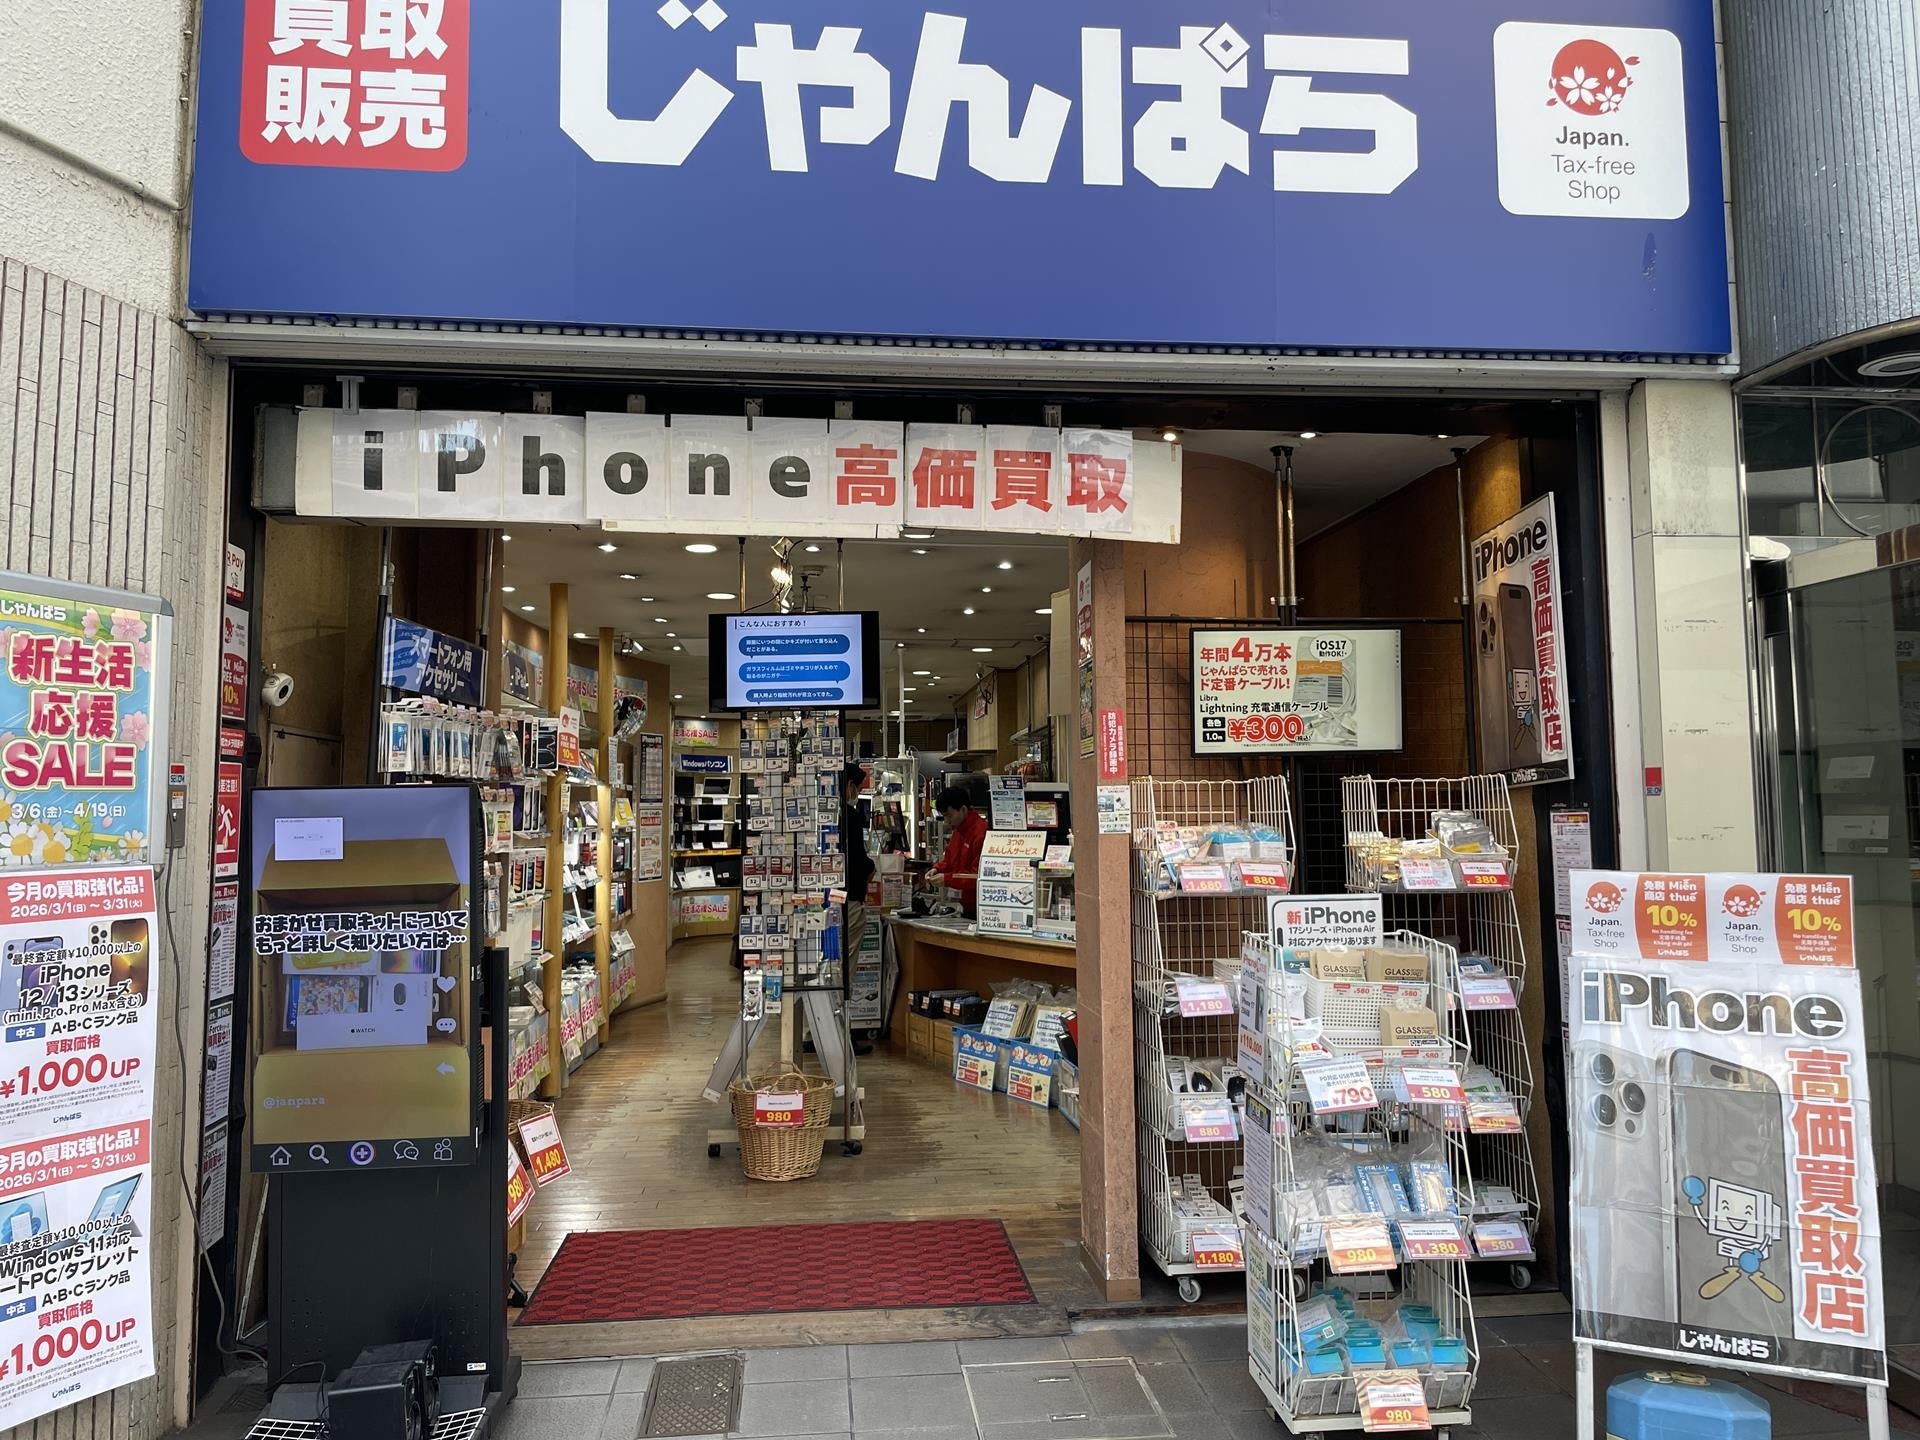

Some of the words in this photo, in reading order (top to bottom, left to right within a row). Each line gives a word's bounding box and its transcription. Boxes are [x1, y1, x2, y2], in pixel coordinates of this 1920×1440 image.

[269, 0, 448, 59] 買取
[560, 0, 1419, 194] じゃんぱら
[261, 65, 448, 149] 販売
[1556, 127, 1630, 150] Japan.
[1551, 154, 1635, 175] Tax-free
[1568, 180, 1620, 204] Shop
[1475, 519, 1548, 583] iPhone
[1, 601, 67, 621] じゃんぱら
[739, 620, 806, 628] こんな人におすすめ！
[1316, 640, 1347, 650] iOS17
[11, 634, 134, 689] 新生活
[409, 634, 472, 673] スマートフォン用
[1531, 557, 1564, 753] 高価買取店
[416, 662, 465, 693] アクセサリー
[1200, 665, 1288, 677] じゃんぱらで売れる
[1200, 677, 1290, 691] ド定番ケーブル!
[224, 685, 239, 705] 10%
[31, 692, 116, 739] 応援
[1200, 704, 1248, 715] Lightning
[1251, 702, 1328, 713] 充電通信ケーブル
[1228, 715, 1304, 742] ¥300
[5, 742, 136, 787] SALE
[682, 759, 726, 768] Windowsパソコン
[988, 847, 1038, 855] あんしんサービス
[1253, 876, 1276, 886] 880
[1475, 875, 1498, 885] 380
[1644, 880, 1664, 890] 免税
[1669, 878, 1697, 890] Miễn
[1785, 883, 1807, 894] 免税
[1811, 881, 1841, 894] Miễn
[8, 876, 144, 902] 今月の買取強化品!
[1669, 891, 1698, 902] thuế
[1811, 894, 1842, 906] thuế
[255, 911, 468, 934] おまかせ買取キットについて
[1286, 911, 1301, 925] 新
[1304, 906, 1377, 925] iPhone
[1588, 917, 1622, 929] Japan.
[1647, 904, 1697, 927] 10%
[1787, 908, 1842, 932] 10%
[1587, 929, 1624, 938] Tax-free
[1725, 921, 1761, 932] Japan.
[255, 933, 467, 955] もっと詳しく知りたい方は…
[1288, 936, 1377, 947] 対応アクセサリあります
[1594, 939, 1618, 949] Shop
[1723, 933, 1764, 943] Tax-free
[12, 942, 141, 966] 最終査定額¥10,000以上の
[1731, 944, 1757, 954] Shop
[40, 963, 110, 985] iPhone
[1323, 965, 1349, 973] GLASS
[1385, 968, 1411, 976] GLASS
[19, 979, 131, 1009] 12/13シリーズ
[1478, 995, 1500, 1005] 480
[1582, 970, 1846, 1040] iPhone
[16, 1026, 36, 1039] 中古
[1395, 1027, 1421, 1035] GLASS
[46, 1034, 101, 1057] 買取価格
[1, 1054, 107, 1098] ¥1,000
[111, 1058, 140, 1078] UP
[1333, 1086, 1373, 1105] ¥790
[1422, 1088, 1450, 1098] 580
[263, 1094, 325, 1109] @janpara
[53, 1112, 82, 1124] じゃんぱら
[766, 1110, 791, 1122] 980
[1199, 1127, 1220, 1136] 880
[1785, 1048, 1868, 1336] 高価買取店
[1491, 1240, 1514, 1250] 580
[0, 1244, 83, 1280] Windows
[1347, 1250, 1377, 1261] 980
[6, 1303, 26, 1316] 中古
[37, 1300, 94, 1330] 買取価格
[106, 1317, 136, 1343] UP
[1679, 1329, 1770, 1359] じゃんぱら
[52, 1383, 81, 1399] じゃんぱら
[1386, 1409, 1412, 1423] 980
